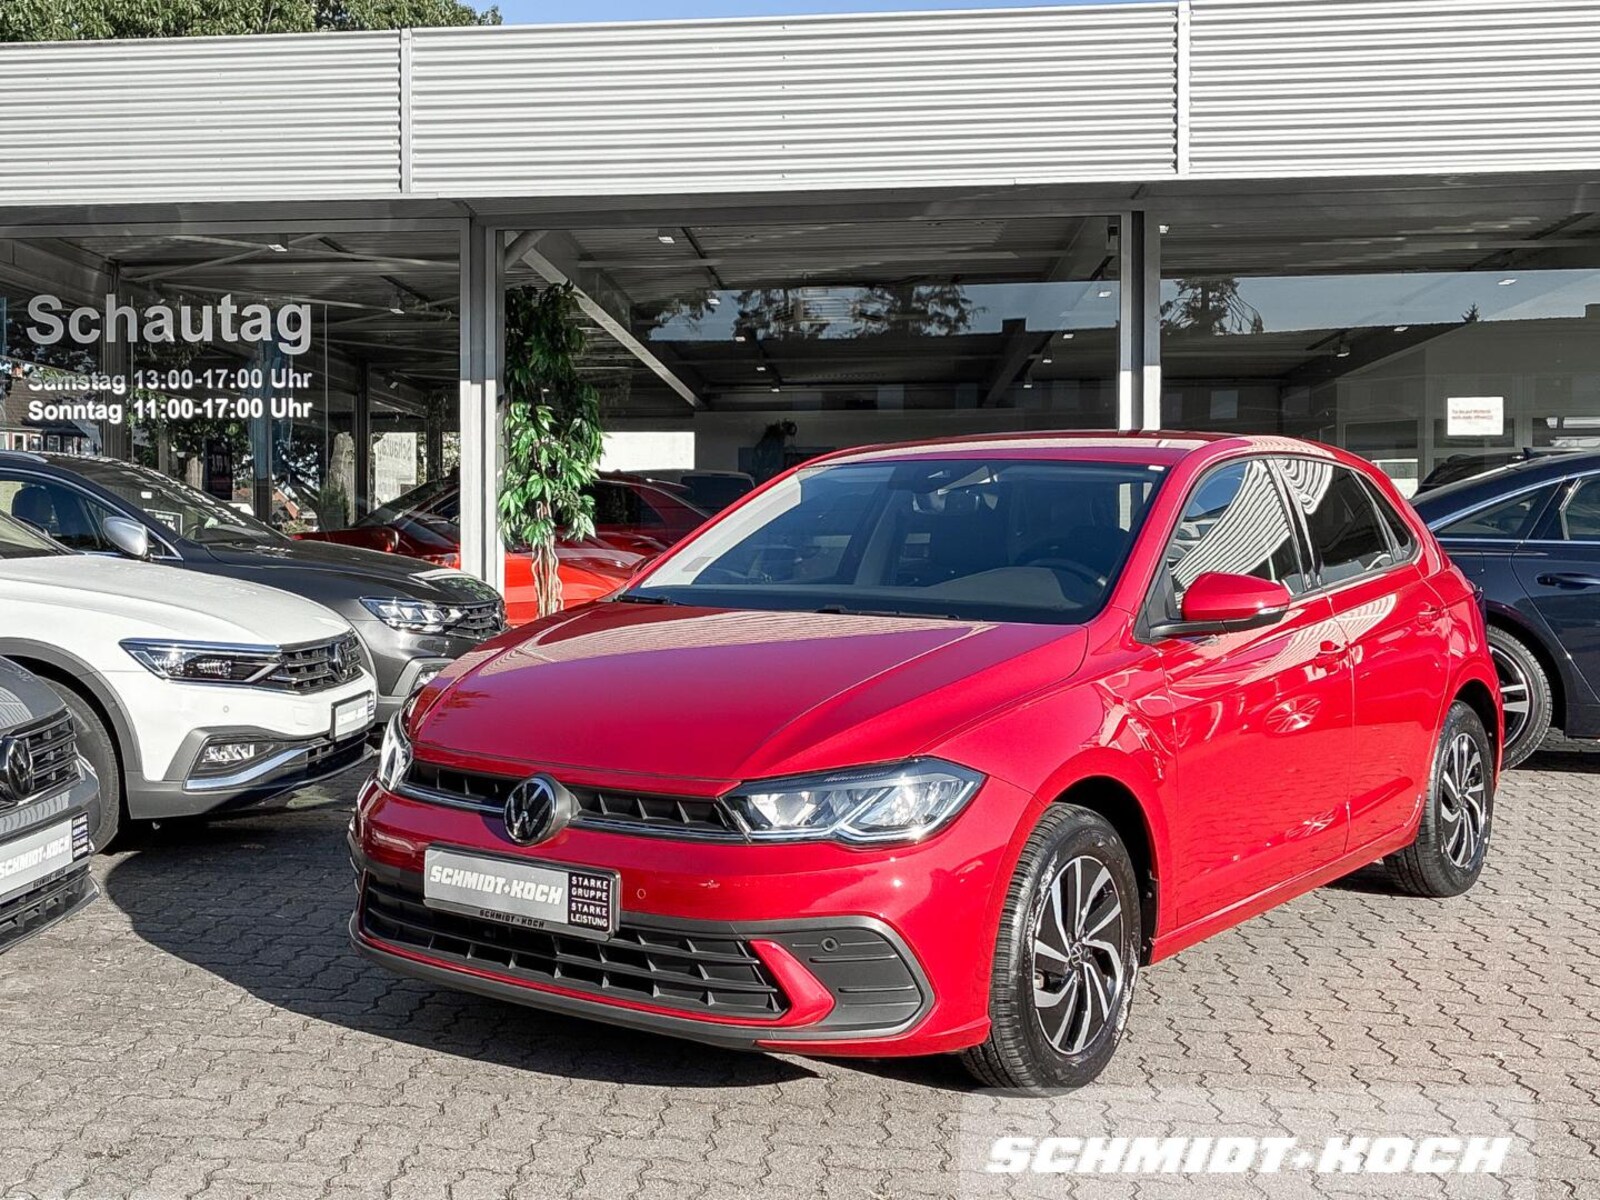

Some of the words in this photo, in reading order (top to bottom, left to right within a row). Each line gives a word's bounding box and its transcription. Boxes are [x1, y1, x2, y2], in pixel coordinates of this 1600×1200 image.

[26, 293, 312, 355] Schautag
[28, 370, 126, 394] Samstag
[134, 368, 263, 389] 13:00-17:00
[271, 368, 312, 388] Uhr
[28, 400, 122, 423] Sonntag
[134, 398, 263, 418] 11:00-17:00
[271, 398, 312, 418] Uhr
[571, 876, 609, 889] STARKE
[571, 887, 608, 901] GRUPPE
[571, 903, 608, 916] STARKE
[570, 915, 608, 928] LEISTUNG
